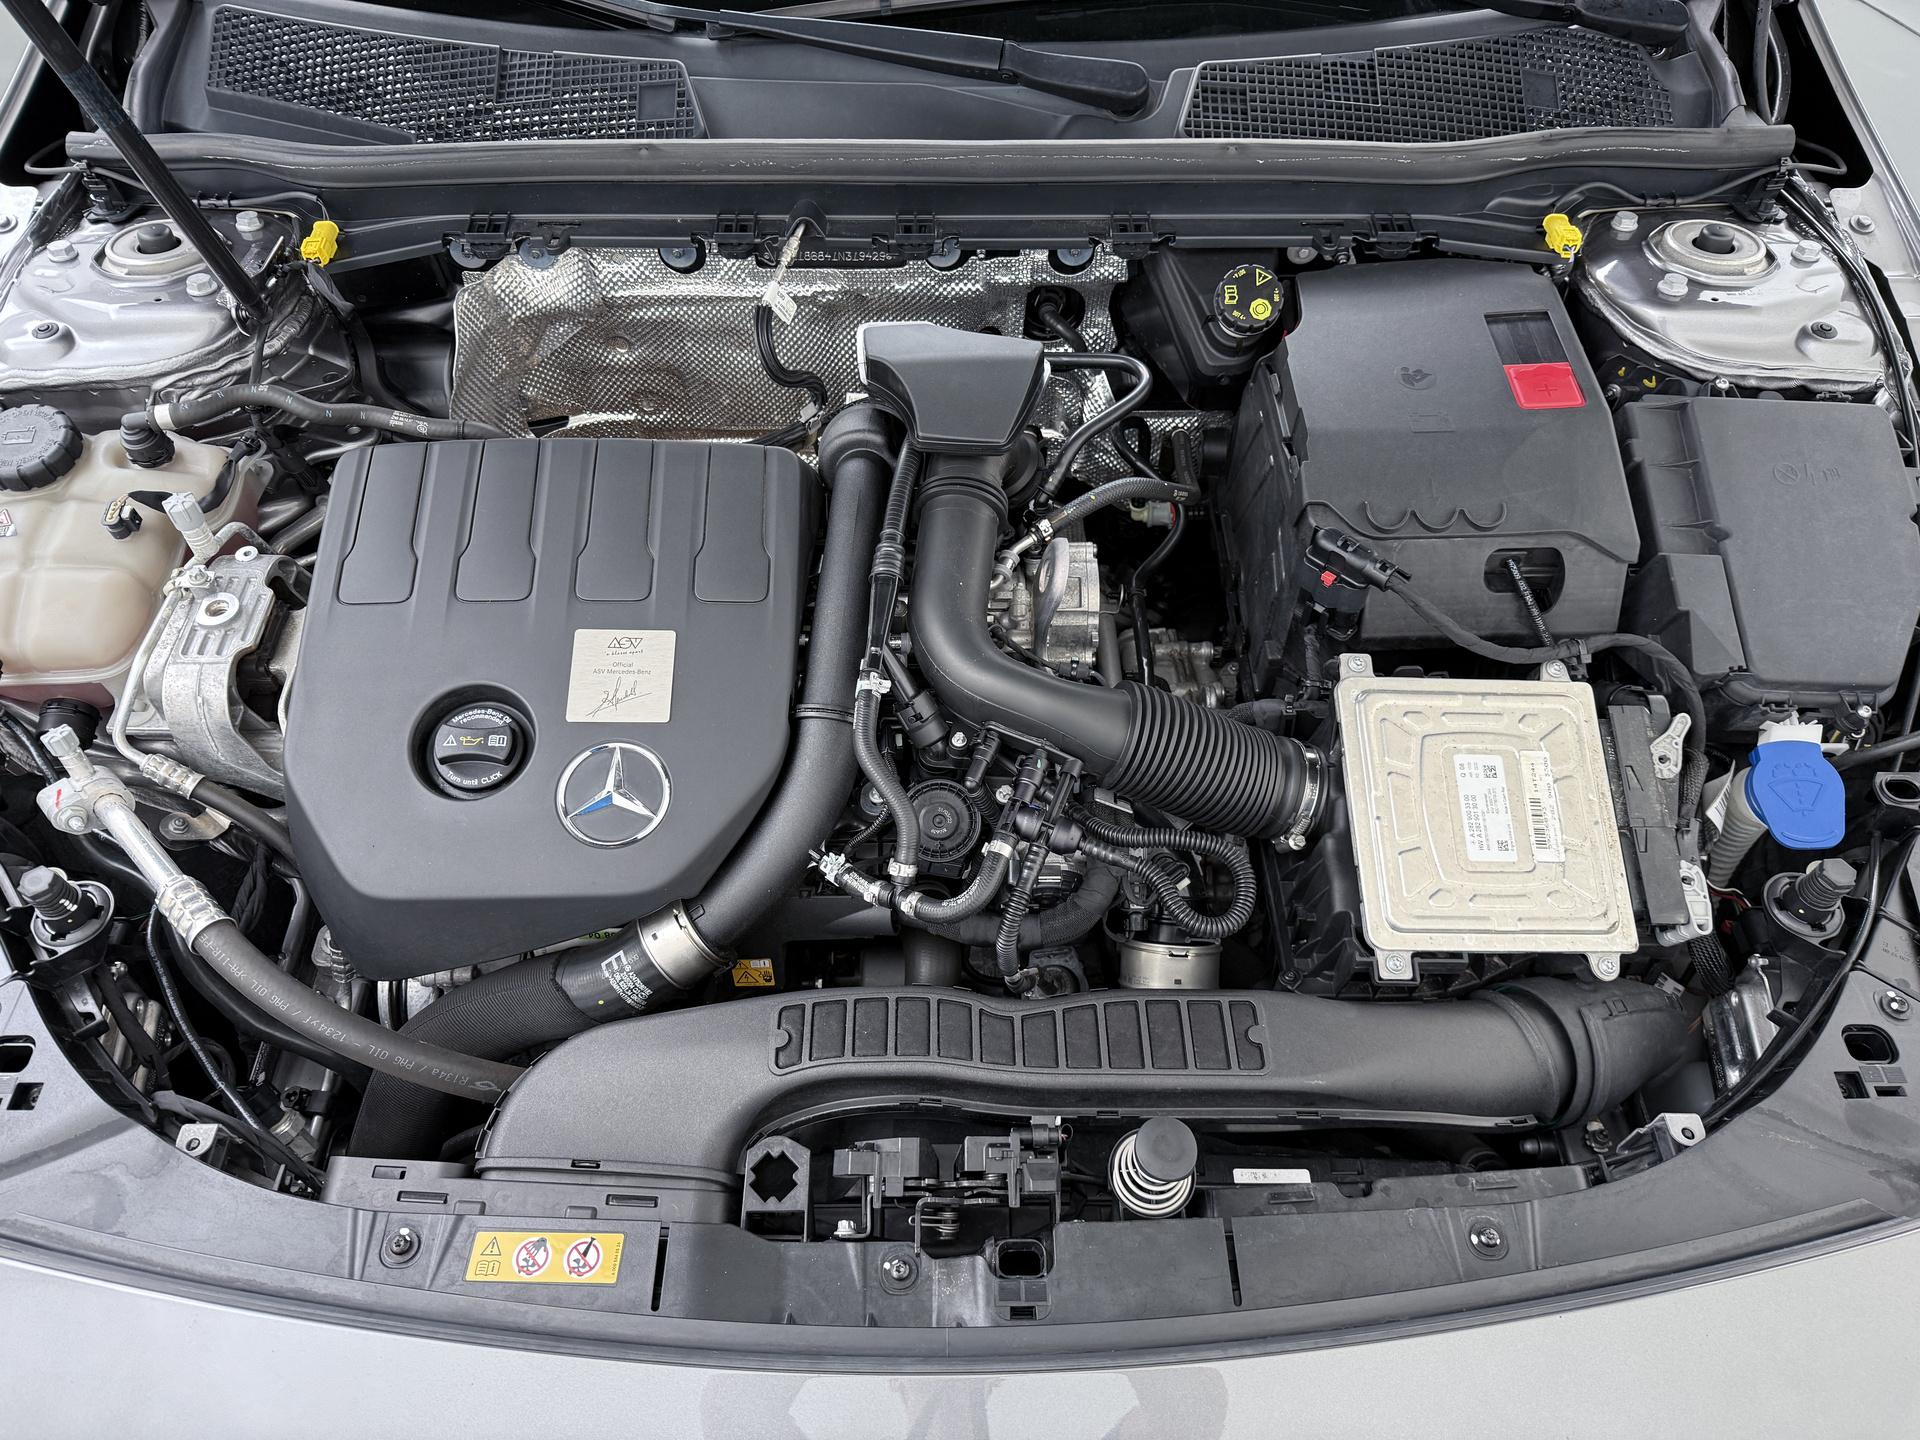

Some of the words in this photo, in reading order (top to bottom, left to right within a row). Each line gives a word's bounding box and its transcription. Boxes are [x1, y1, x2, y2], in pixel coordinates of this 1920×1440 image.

[451, 708, 504, 723] Mercedes-Benz
[460, 713, 505, 726] recommended
[447, 770, 461, 783] Turn
[481, 771, 503, 784] CLICK
[249, 979, 268, 997] OIL
[368, 1044, 389, 1060] OIL
[394, 1056, 415, 1070] PAG
[431, 1067, 469, 1086] R134a
